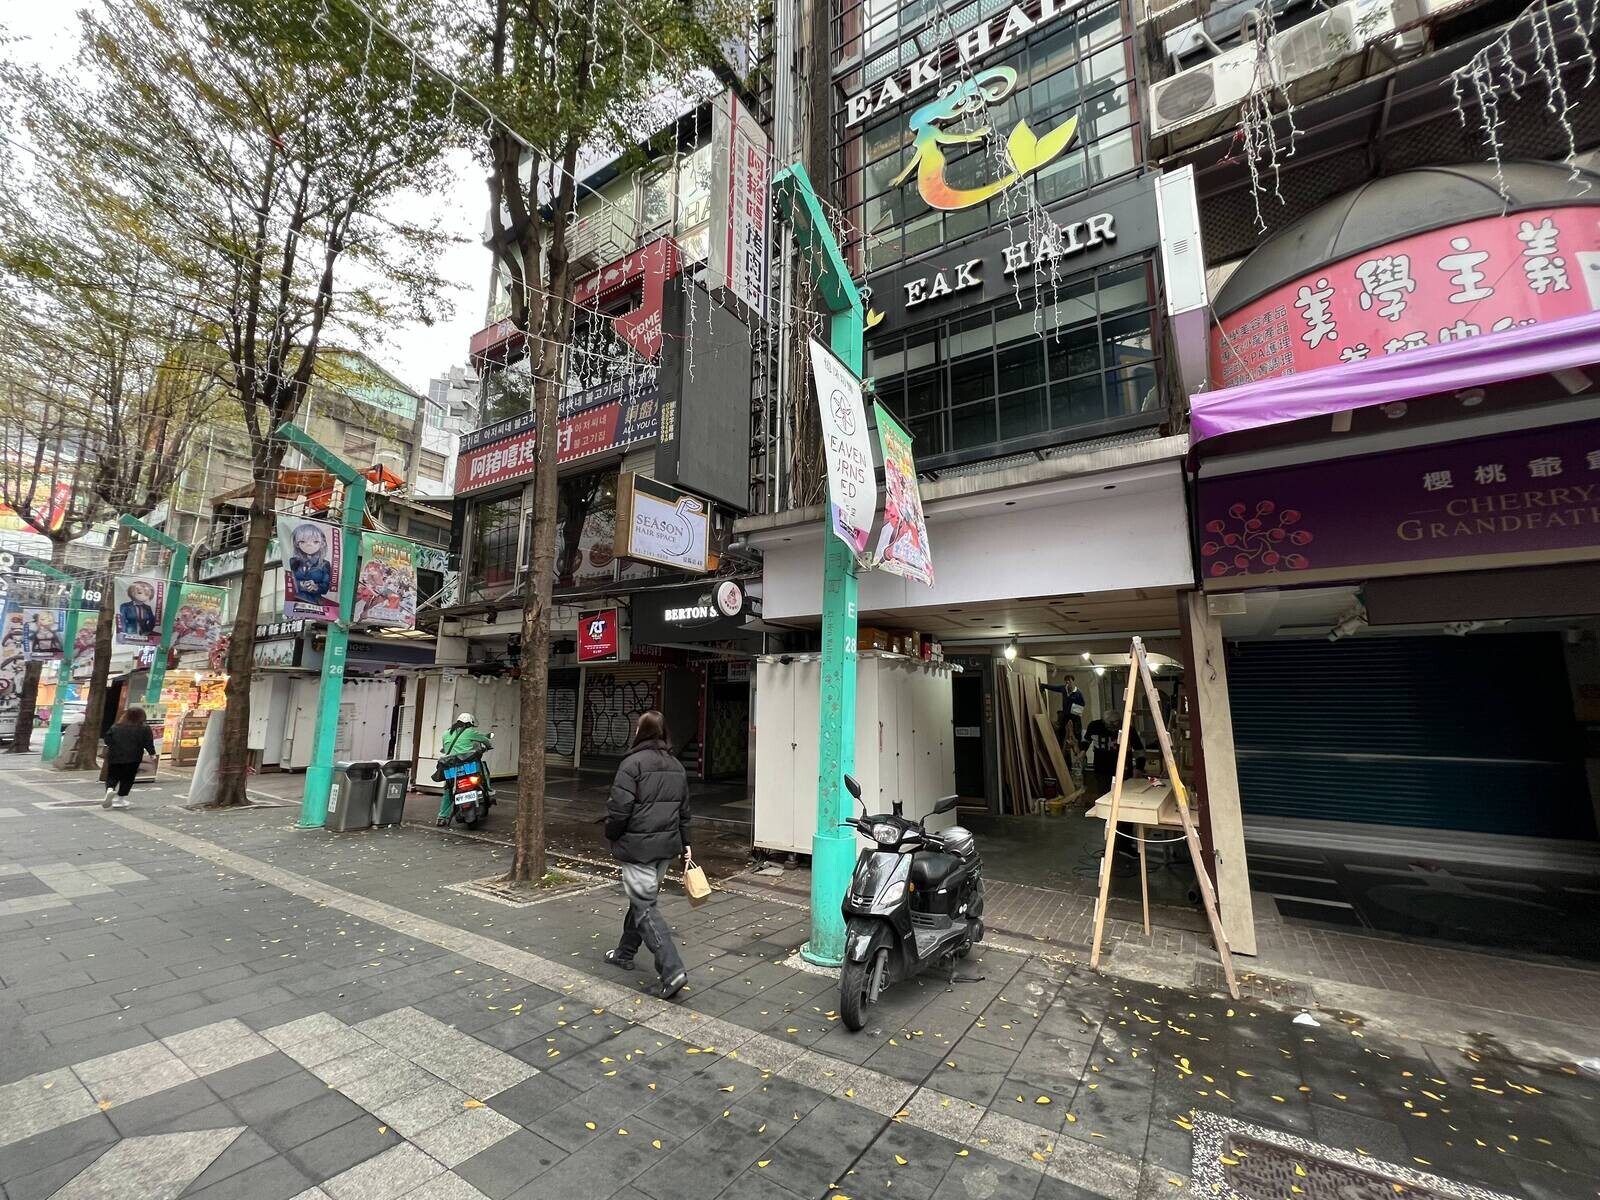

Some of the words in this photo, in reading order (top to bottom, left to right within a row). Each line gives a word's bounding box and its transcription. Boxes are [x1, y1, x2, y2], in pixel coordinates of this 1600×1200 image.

[845, 52, 941, 128] EAK
[955, 0, 1083, 68] HAI
[902, 259, 984, 309] EAK
[1001, 212, 1117, 275] HAIR
[1293, 217, 1571, 350] 美學主義
[631, 309, 661, 340] COME
[624, 398, 659, 424] 銅盤
[1446, 483, 1595, 517] CHERRY
[635, 525, 655, 538] HAIR
[656, 531, 677, 543] SPACE
[636, 513, 683, 537] SEASON
[664, 606, 709, 621] BERTON
[847, 602, 856, 618] E
[334, 646, 343, 655] E
[845, 635, 857, 653] 28
[329, 665, 343, 675] 26
